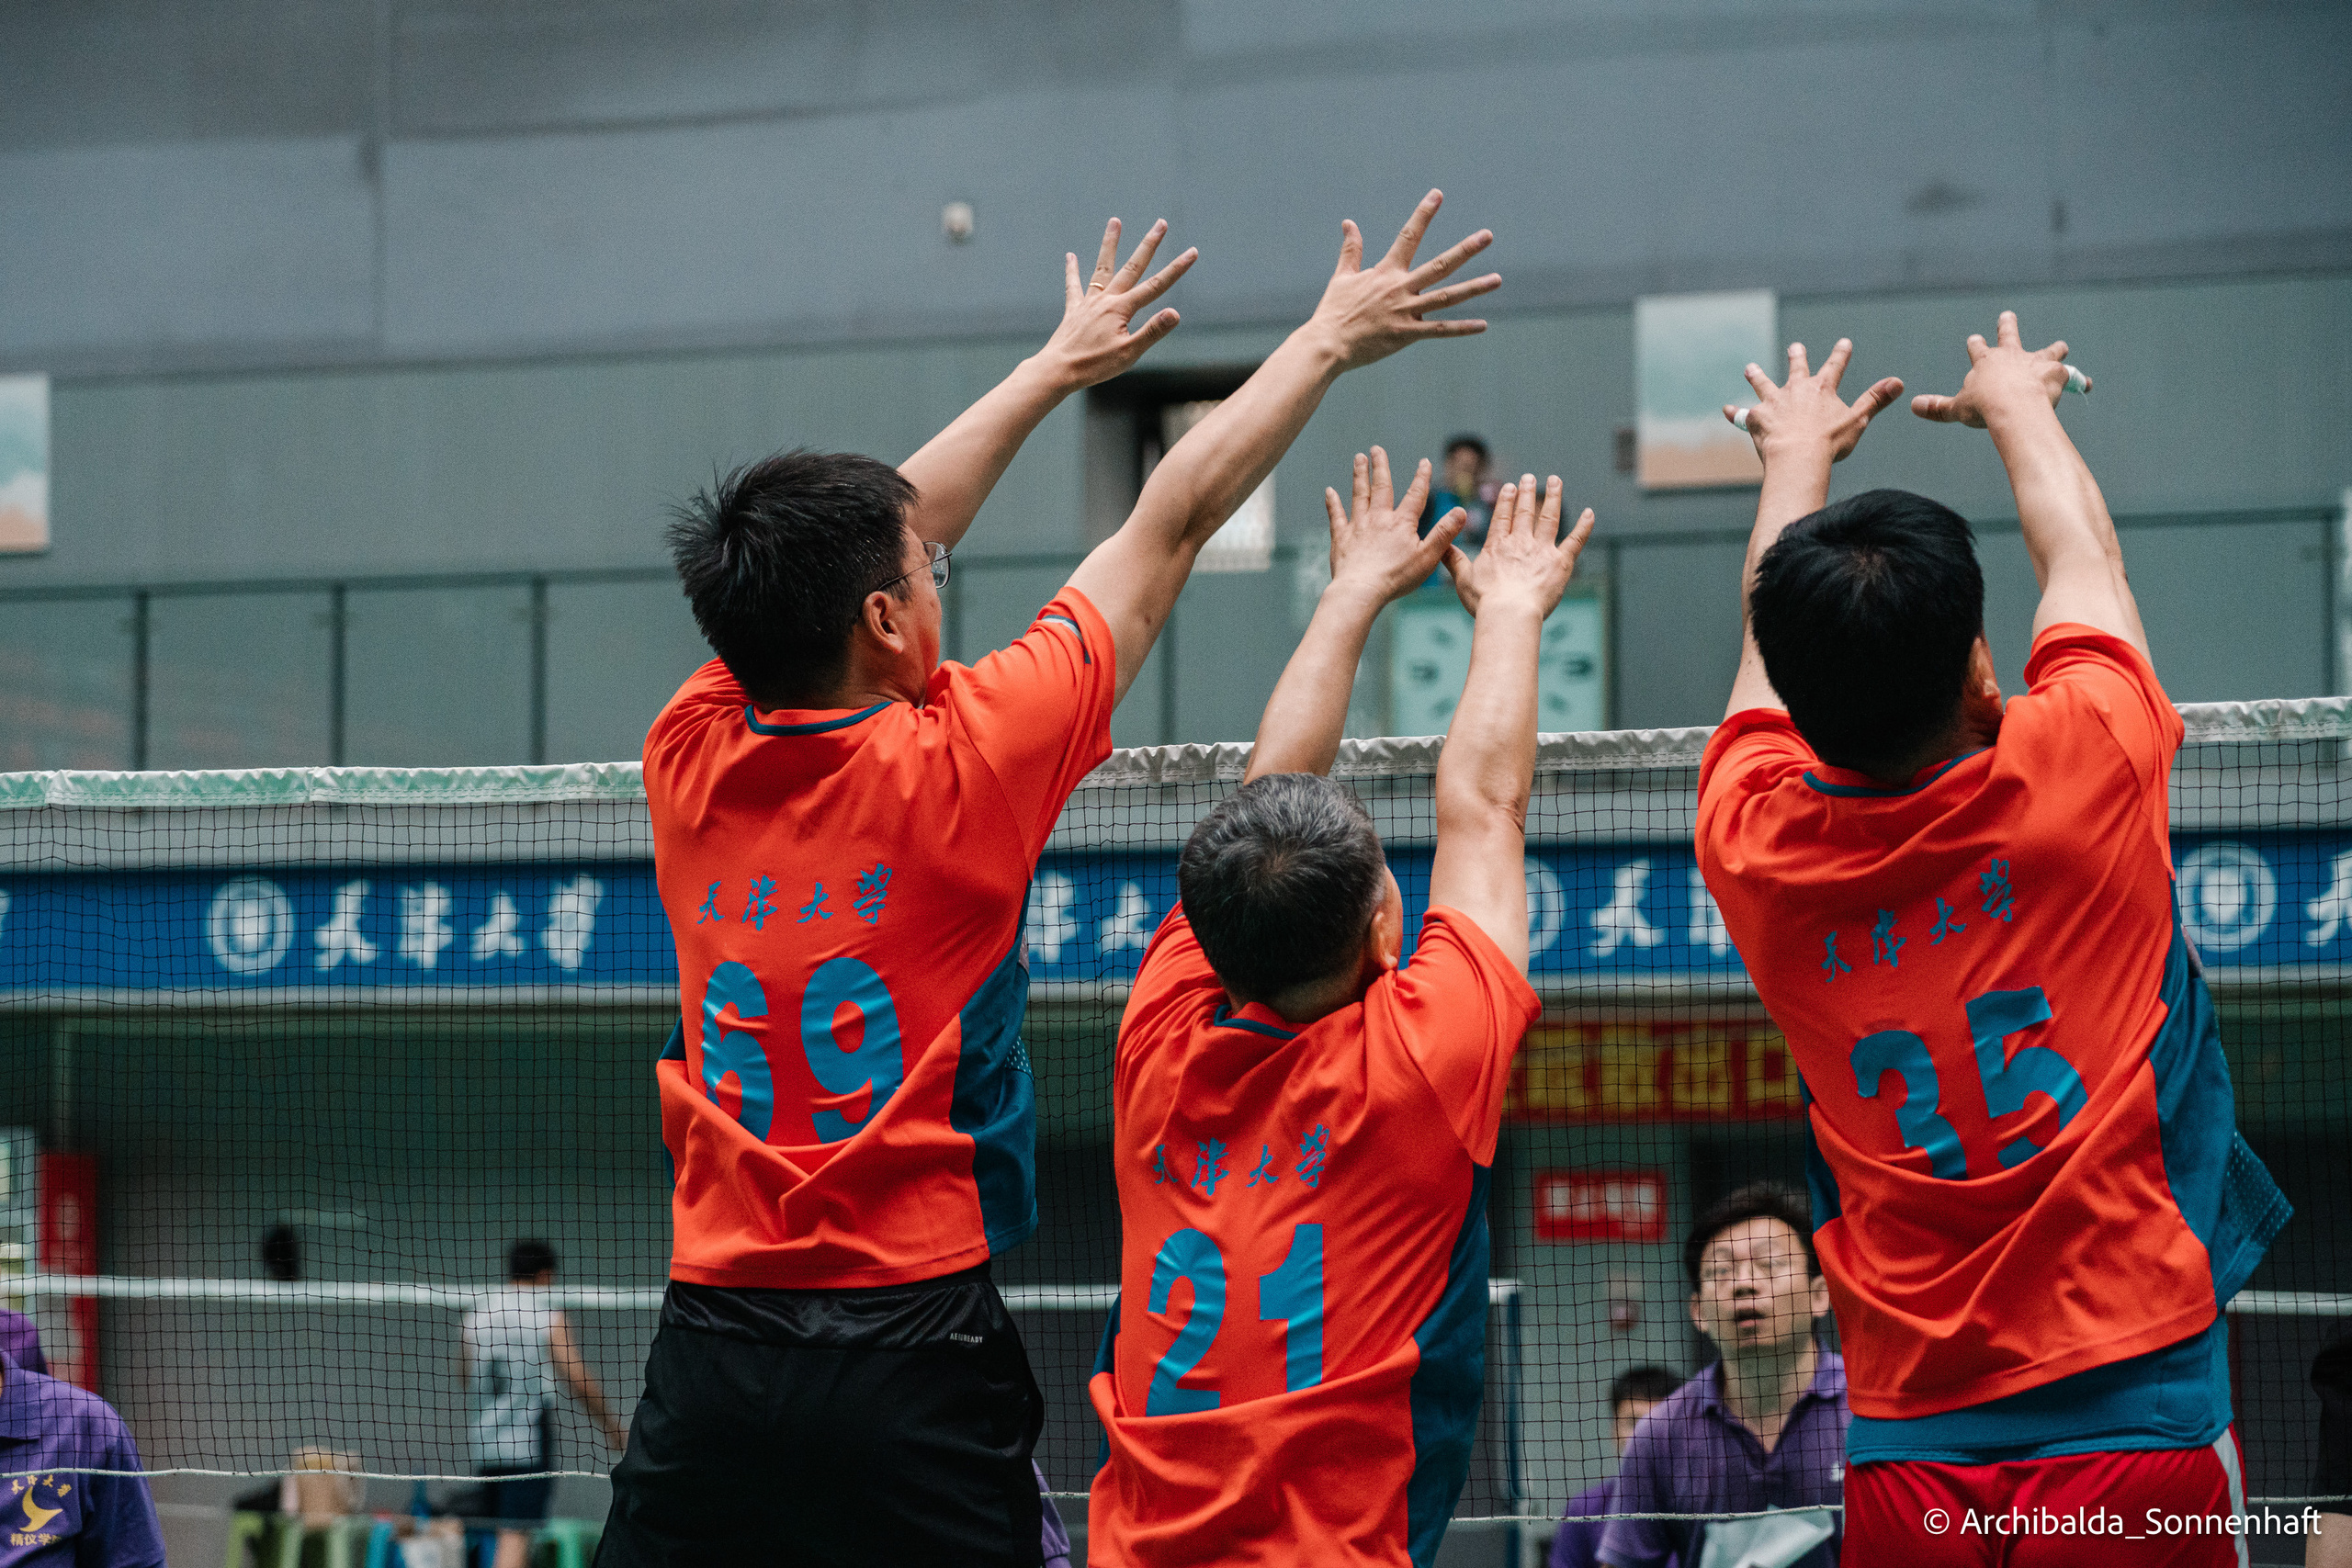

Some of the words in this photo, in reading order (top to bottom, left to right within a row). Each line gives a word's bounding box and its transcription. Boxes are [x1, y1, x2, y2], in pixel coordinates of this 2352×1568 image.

[696, 863, 893, 931] 天津大学
[1820, 858, 2015, 983] 天津大学
[701, 956, 904, 1145] 69
[1849, 986, 2089, 1180] 35
[1152, 1122, 1330, 1196] 天津大学
[1145, 1223, 1324, 1417] 21
